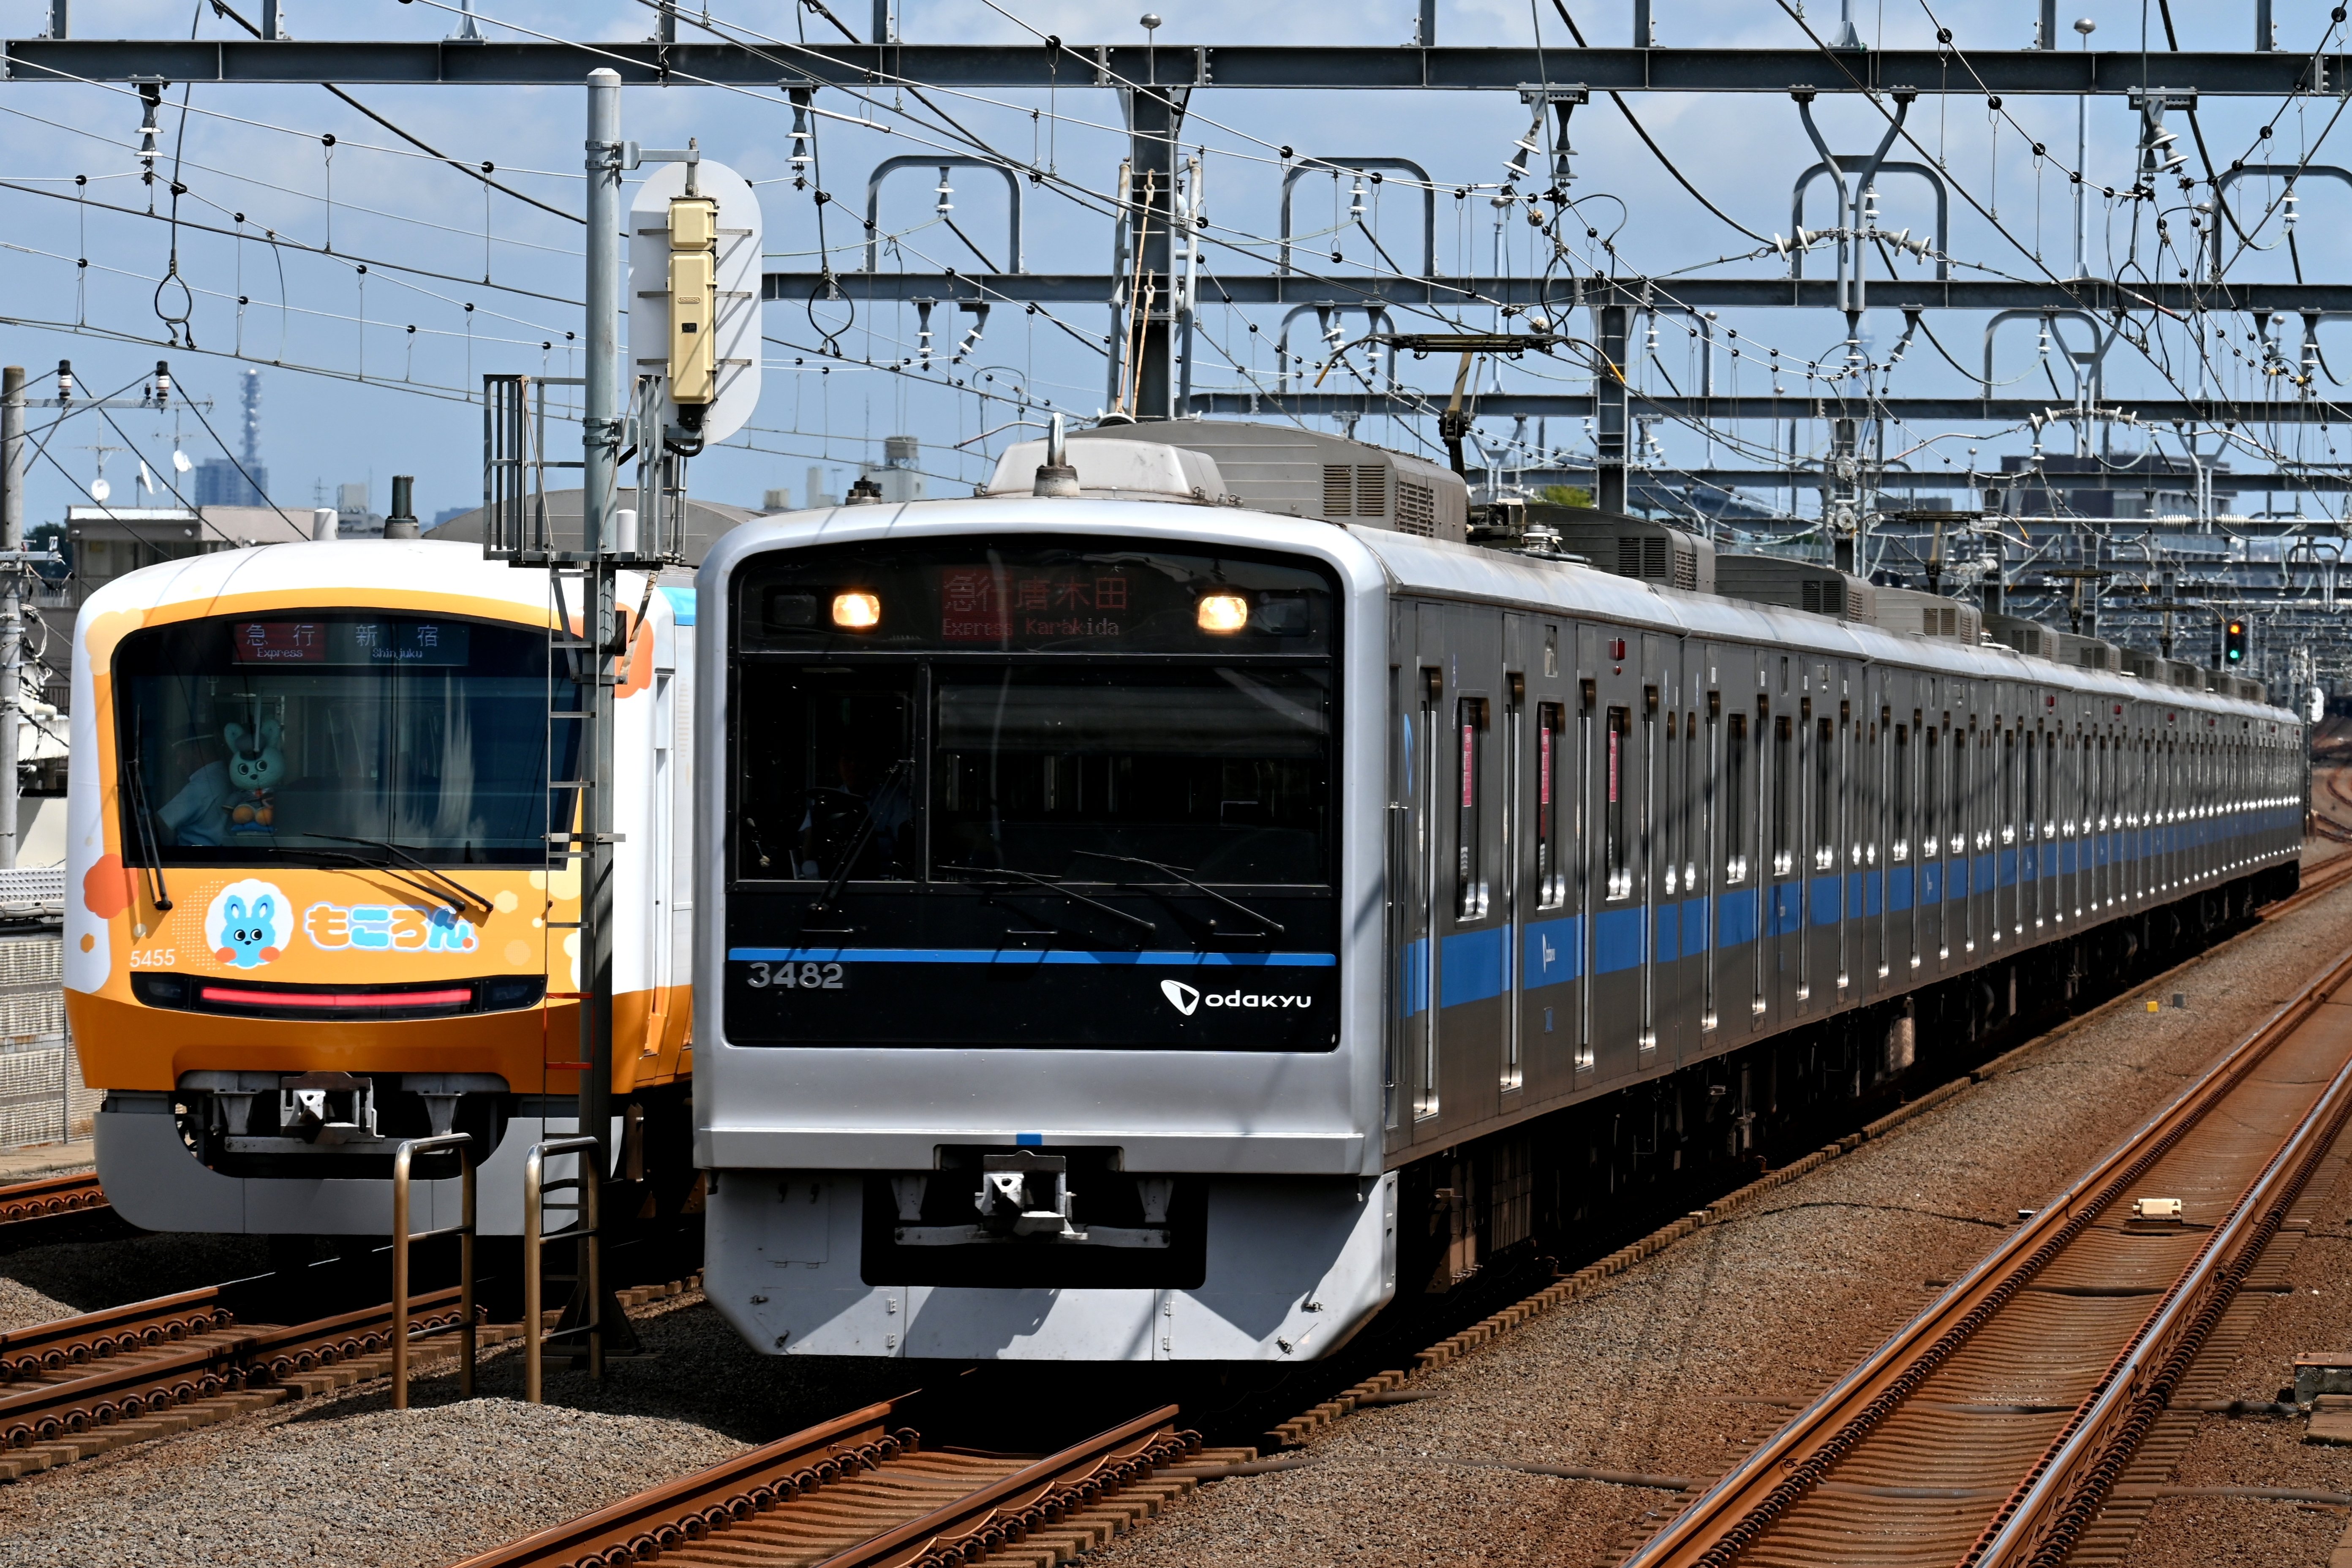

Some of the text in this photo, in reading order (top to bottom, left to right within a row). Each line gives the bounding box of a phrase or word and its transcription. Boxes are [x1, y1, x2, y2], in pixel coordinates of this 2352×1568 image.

[944, 575, 1011, 612] 急行
[1016, 575, 1127, 610] 唐木田
[246, 624, 315, 646] 急行
[355, 624, 438, 647] 新宿
[1026, 618, 1119, 635] Karakida
[257, 648, 303, 659] Express
[372, 648, 422, 661] Shinjuku
[304, 902, 478, 952] もころん
[130, 948, 175, 968] 5455
[747, 962, 844, 988] 3482
[1205, 990, 1312, 1008] odakyu
